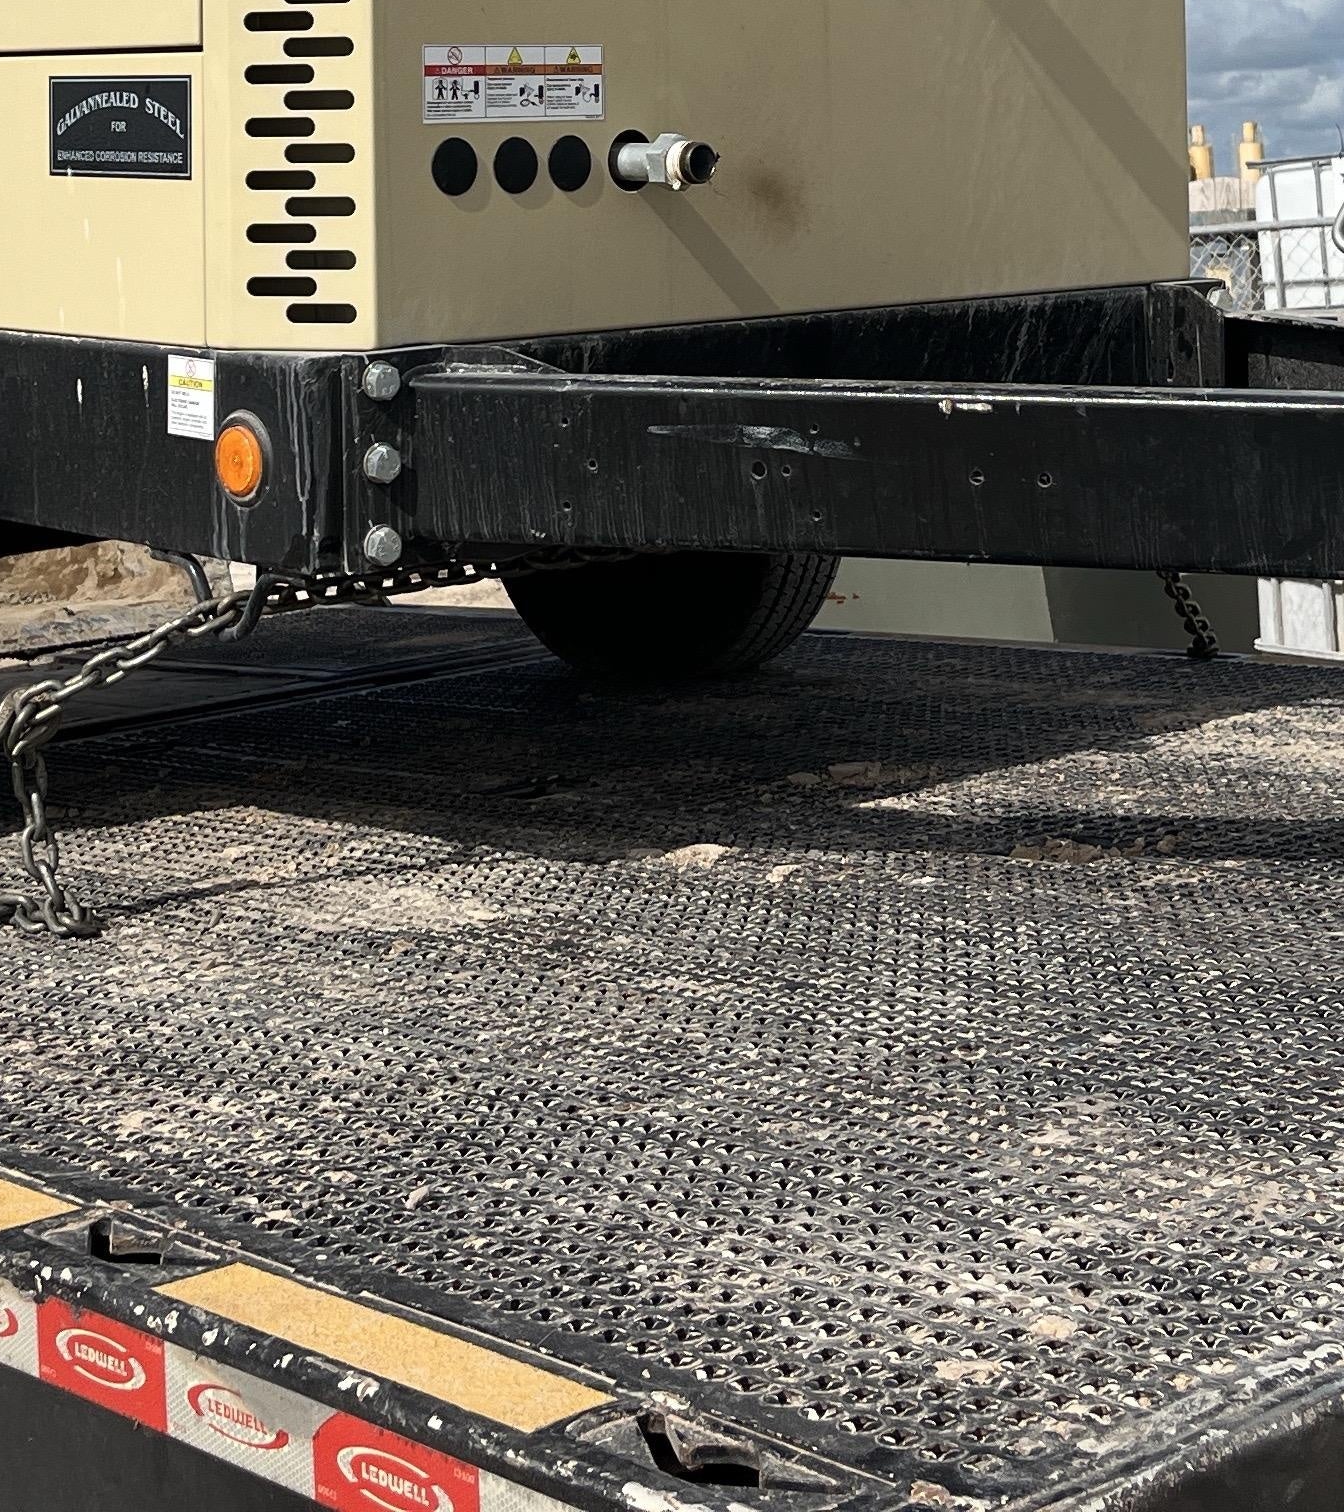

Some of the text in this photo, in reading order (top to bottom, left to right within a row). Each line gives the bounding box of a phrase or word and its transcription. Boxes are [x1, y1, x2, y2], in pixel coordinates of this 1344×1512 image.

[441, 66, 474, 75] DANGER
[56, 91, 185, 140] GALVANNEALED STEEL
[110, 120, 127, 133] FOR
[57, 149, 95, 162] ENHANCED
[137, 151, 184, 165] RESISTANCE
[74, 1341, 129, 1377] LEDWELL
[207, 1396, 269, 1436] LEDWELL
[360, 1461, 431, 1507] LEDWELL
